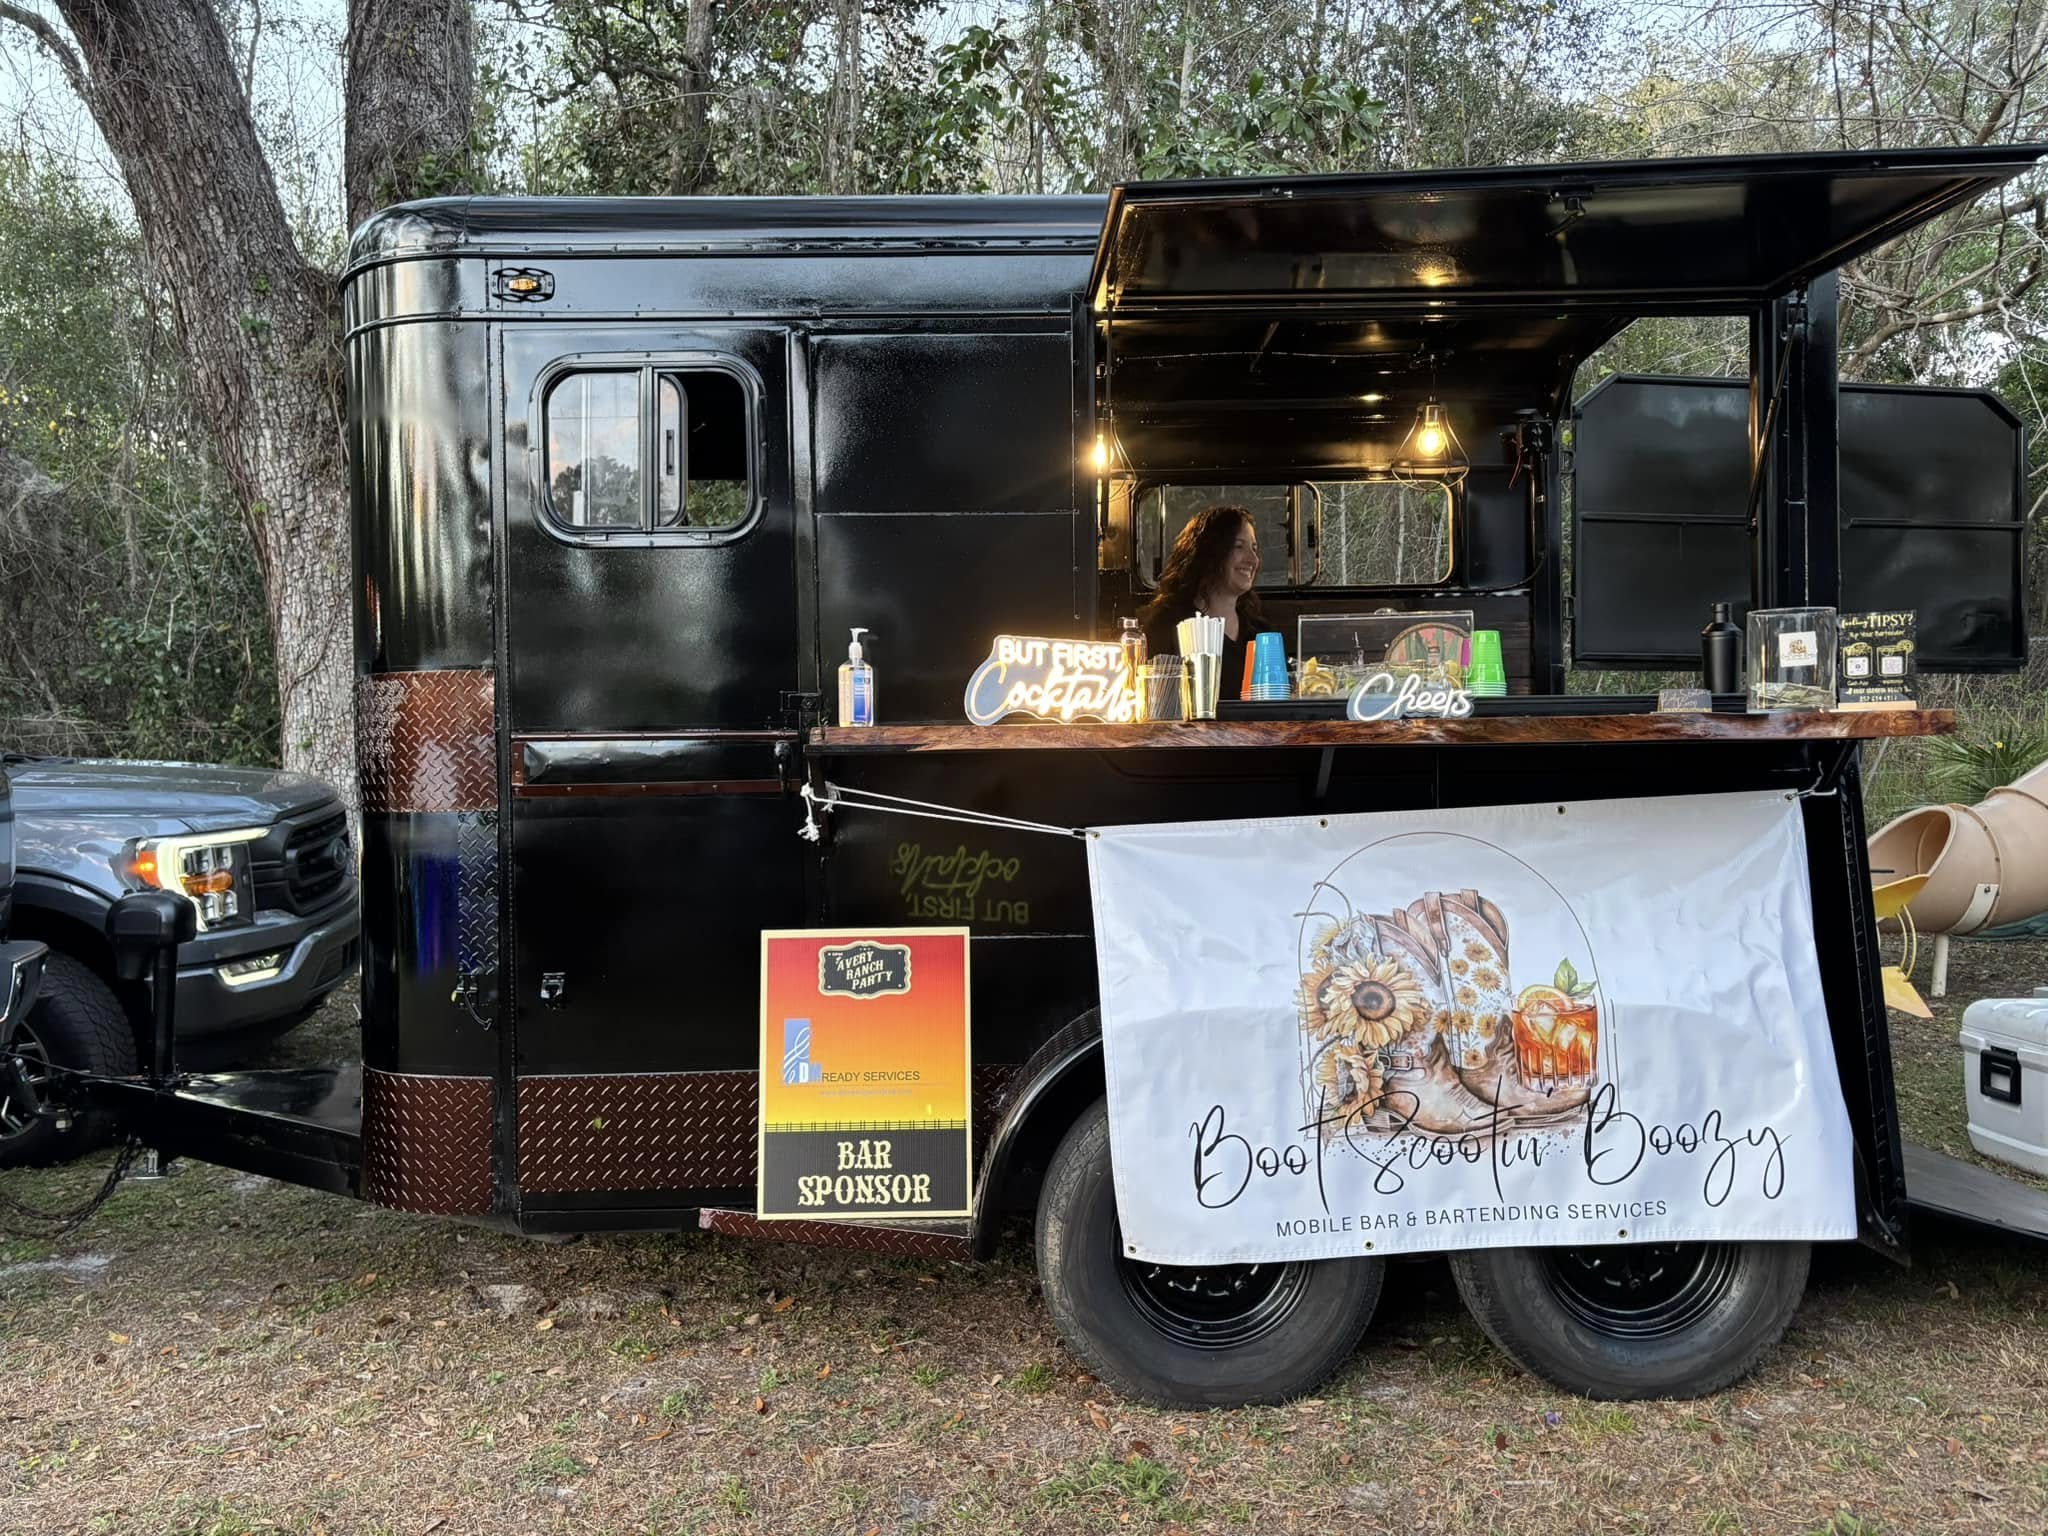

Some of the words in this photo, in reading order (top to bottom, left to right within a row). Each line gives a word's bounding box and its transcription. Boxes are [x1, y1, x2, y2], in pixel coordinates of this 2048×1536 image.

[1866, 613, 1914, 629] TIPSY?
[999, 637, 1050, 667] BUT
[1052, 642, 1126, 673] FIRST,
[971, 660, 1139, 723] Cocktails
[1353, 672, 1474, 721] Cheers
[836, 950, 874, 972] AVERY
[846, 959, 884, 980] RANCH
[852, 970, 893, 990] PARTY
[821, 1071, 861, 1082] READY
[863, 1070, 921, 1082] SERVICES
[837, 1139, 892, 1171] BAR
[1189, 1085, 1347, 1215] Boot
[1584, 1082, 1792, 1208] Boozy
[798, 1172, 932, 1207] SPONSOR
[1276, 1215, 1352, 1238] MOBILE
[1360, 1213, 1400, 1231] BAR
[1406, 1211, 1417, 1227] &
[1426, 1204, 1560, 1226] BARTENDING
[1567, 1200, 1668, 1220] SERVICES
